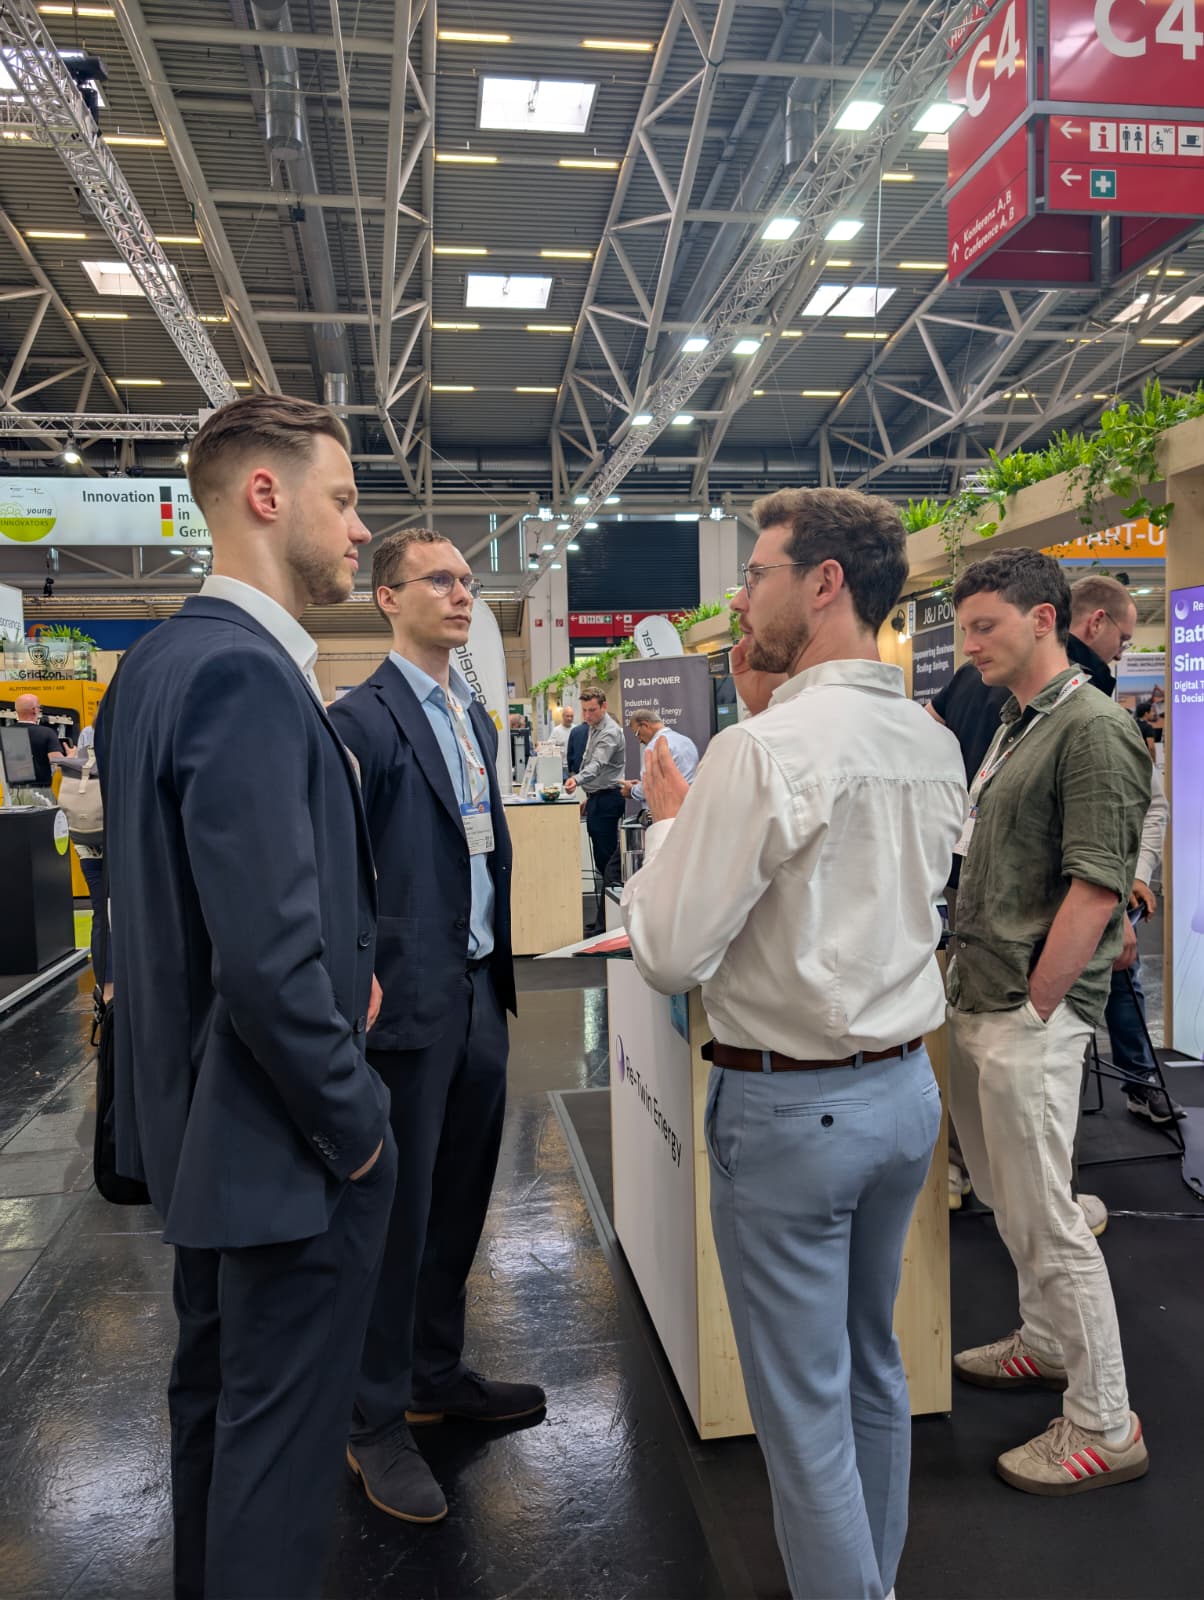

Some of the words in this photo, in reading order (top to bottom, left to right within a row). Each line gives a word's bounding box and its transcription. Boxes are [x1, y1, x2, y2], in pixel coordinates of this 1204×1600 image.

[1094, 0, 1204, 61] C4
[966, 1, 1020, 117] C4
[964, 208, 996, 244] Konferenz
[964, 224, 999, 260] Conference
[82, 490, 155, 503] Innovation
[26, 508, 53, 516] young
[178, 508, 190, 520] in
[923, 605, 937, 625] J&J
[1174, 680, 1198, 692] Digital
[624, 698, 652, 708] Industrial
[653, 698, 659, 706] &
[661, 707, 682, 716] Energy
[626, 1055, 653, 1117] Re-Twin
[653, 1096, 682, 1168] Energy
